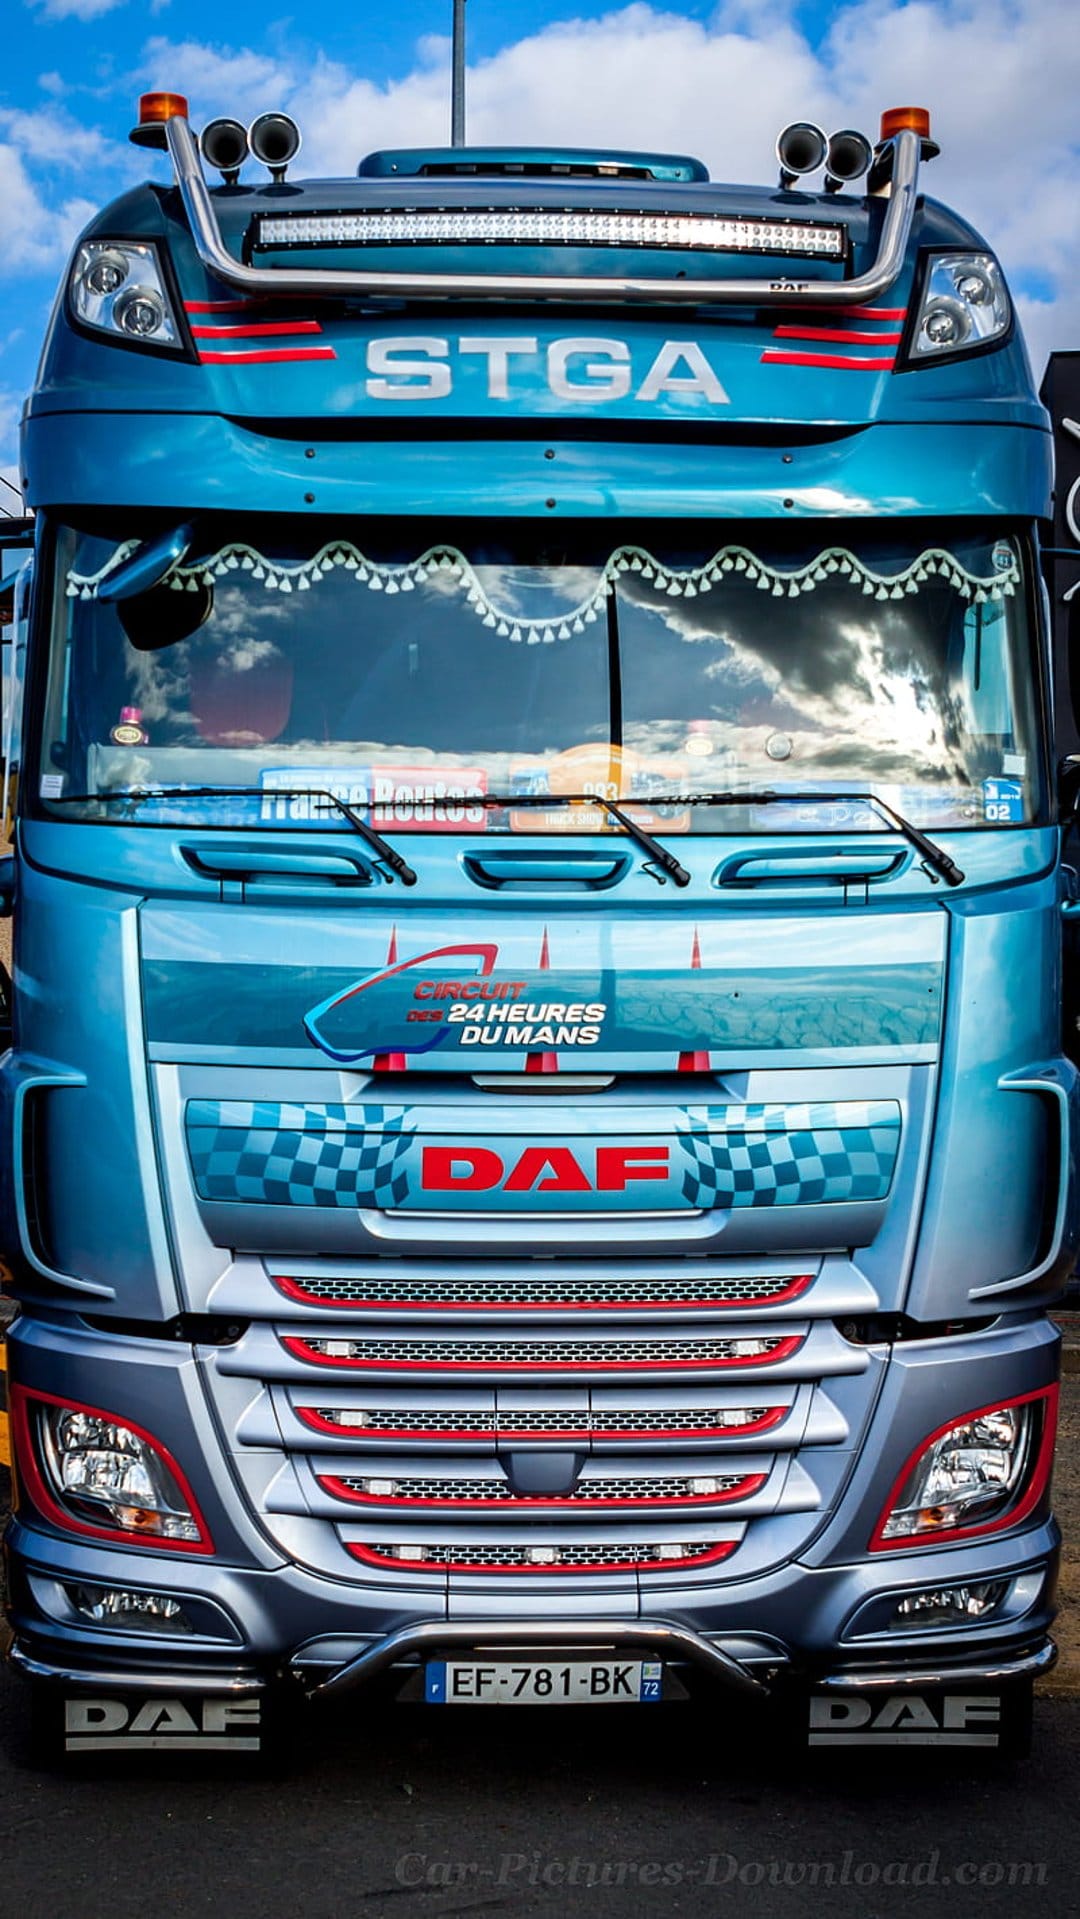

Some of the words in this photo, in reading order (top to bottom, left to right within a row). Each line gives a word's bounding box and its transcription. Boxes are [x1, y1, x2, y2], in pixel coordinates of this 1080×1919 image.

[769, 282, 809, 295] DAF
[365, 336, 732, 404] STGA
[260, 777, 369, 821] France
[373, 777, 485, 823] Routes
[986, 804, 1011, 820] 02
[414, 981, 528, 1000] CIRCUIT
[406, 1009, 444, 1023] DES
[448, 1003, 485, 1023] 24
[487, 1003, 607, 1023] HEURES
[459, 1026, 500, 1045] DU
[503, 1026, 601, 1045] MANS
[422, 1146, 670, 1191] DAF
[452, 1665, 635, 1697] EF-781-BK
[642, 1681, 659, 1696] 72
[65, 1699, 261, 1732] DAF
[809, 1696, 1001, 1728] DAF
